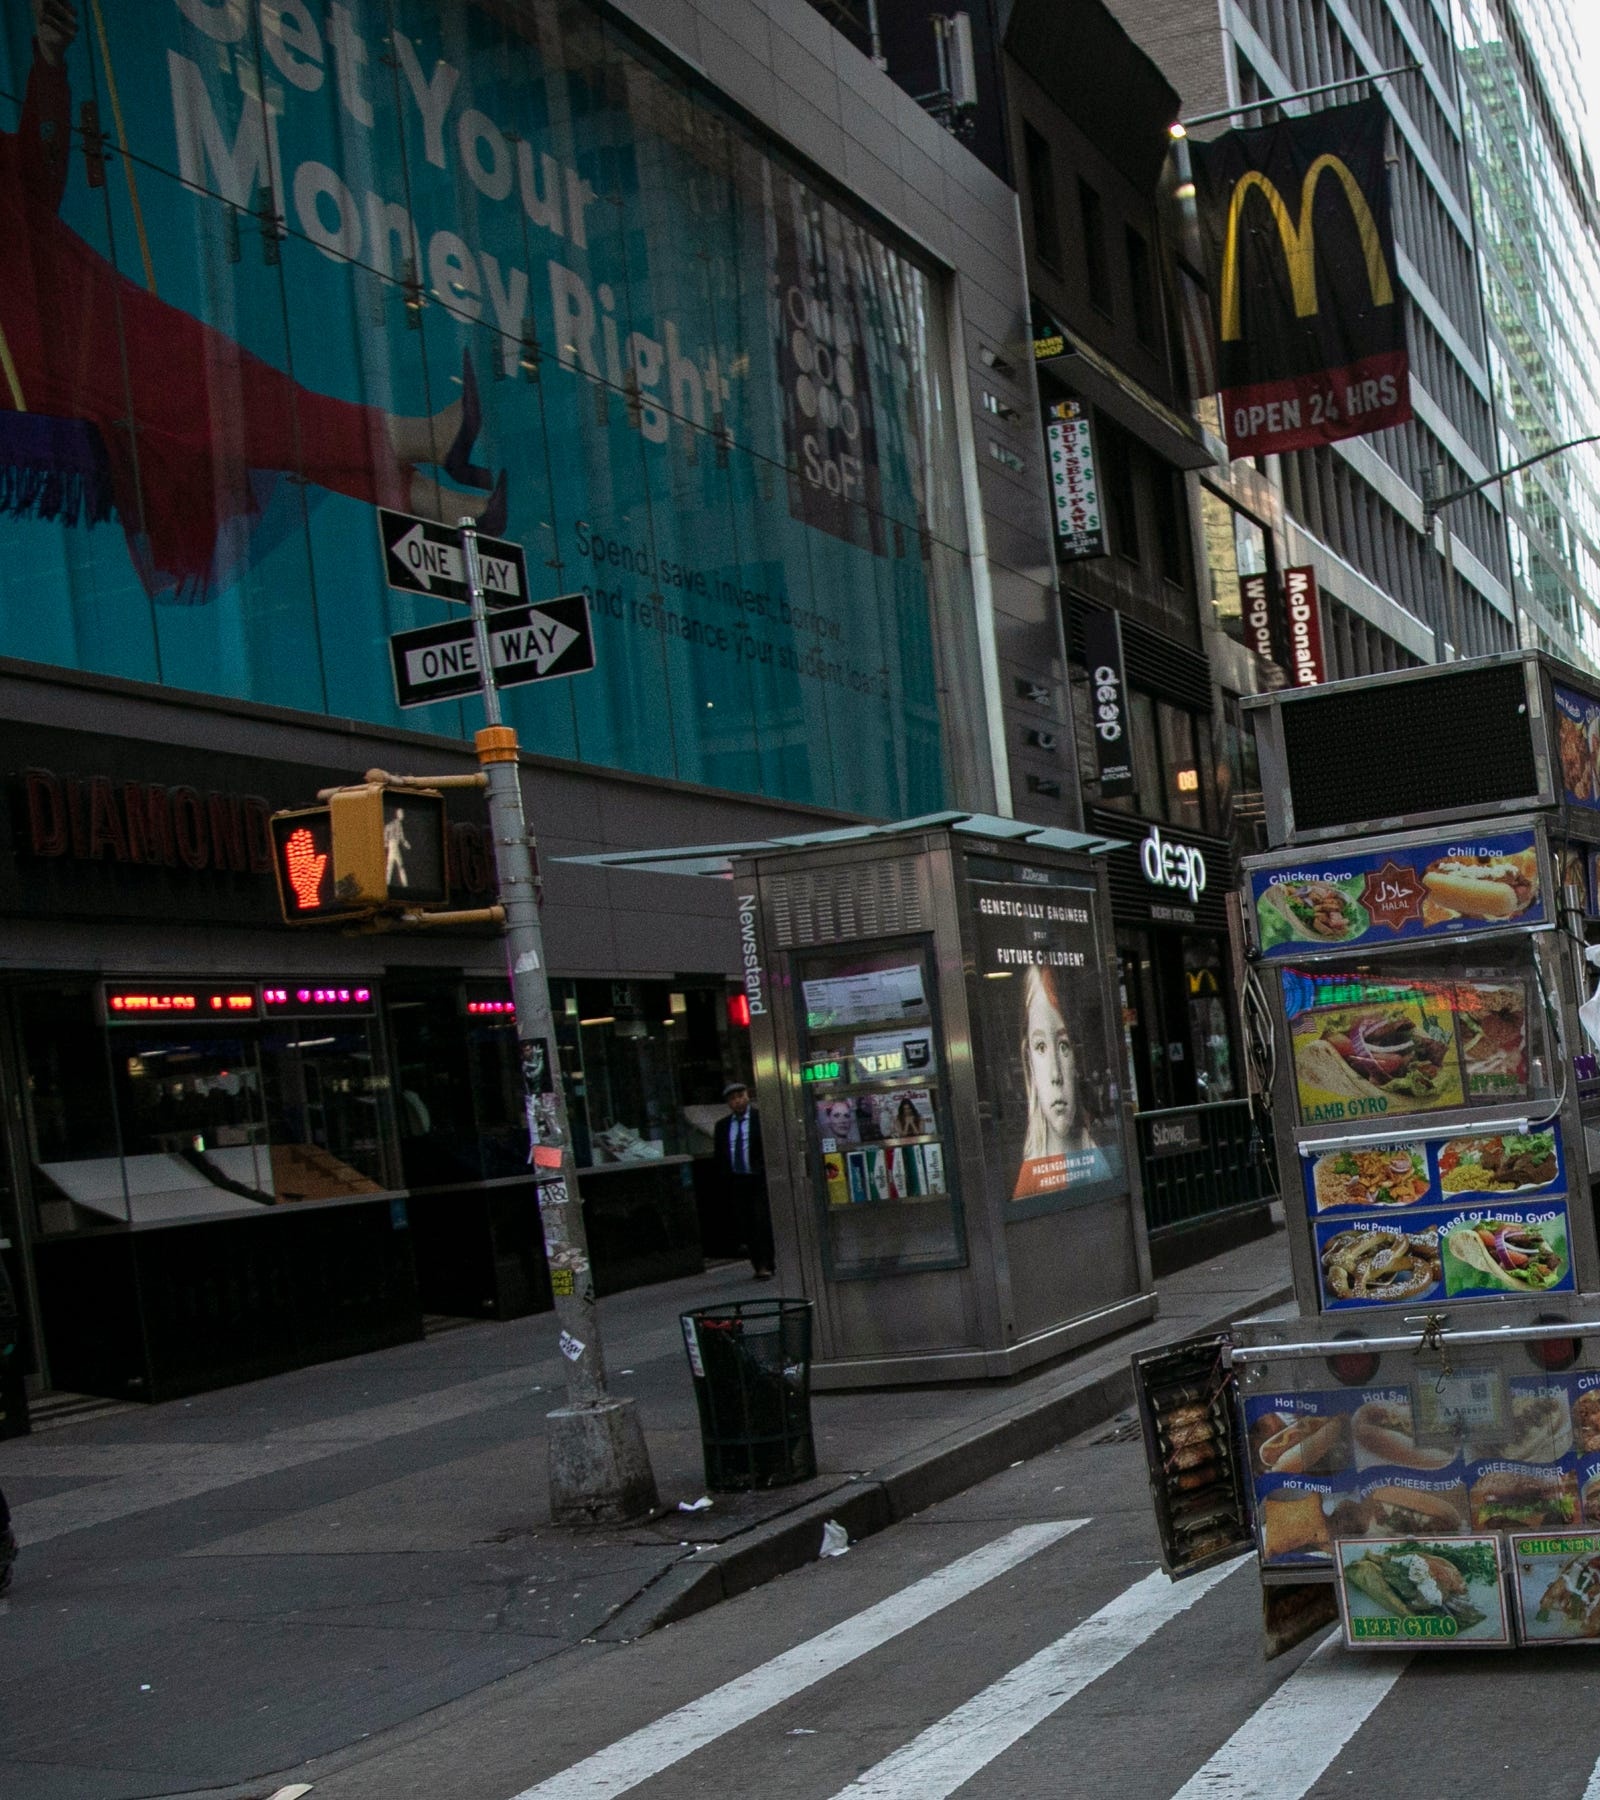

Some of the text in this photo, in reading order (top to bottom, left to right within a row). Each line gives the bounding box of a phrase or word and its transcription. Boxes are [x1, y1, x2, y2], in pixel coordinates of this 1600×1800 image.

[393, 28, 597, 249] Your
[168, 49, 528, 377] Money
[1235, 375, 1397, 437] OPEN 24 HRS
[407, 540, 508, 590] ONE AY
[422, 624, 558, 678] ONE WAY
[1448, 847, 1503, 858] Chili Dog
[1269, 871, 1352, 885] Chicken Gyro
[1375, 880, 1414, 903] حلال
[980, 898, 1089, 923] GENETICALLY ENGINEER
[1381, 900, 1410, 911] HALAL
[738, 894, 768, 1017] Newsstand
[997, 948, 1034, 965] FUTURE
[1304, 1097, 1388, 1122] LAMB GYRO
[1354, 1221, 1402, 1235] Hot Pretzel
[1437, 1210, 1556, 1237] Beef or Lamb Gyro
[1275, 1398, 1318, 1414] Hot Dog
[1362, 1391, 1387, 1404] Hot
[1477, 1462, 1565, 1478] CHEESEBURGER
[1283, 1480, 1332, 1494] HOT KNISH
[1360, 1476, 1392, 1498] PHILLY
[1519, 1536, 1595, 1556] CHICKEN
[1353, 1615, 1458, 1639] BEEF GYRO
